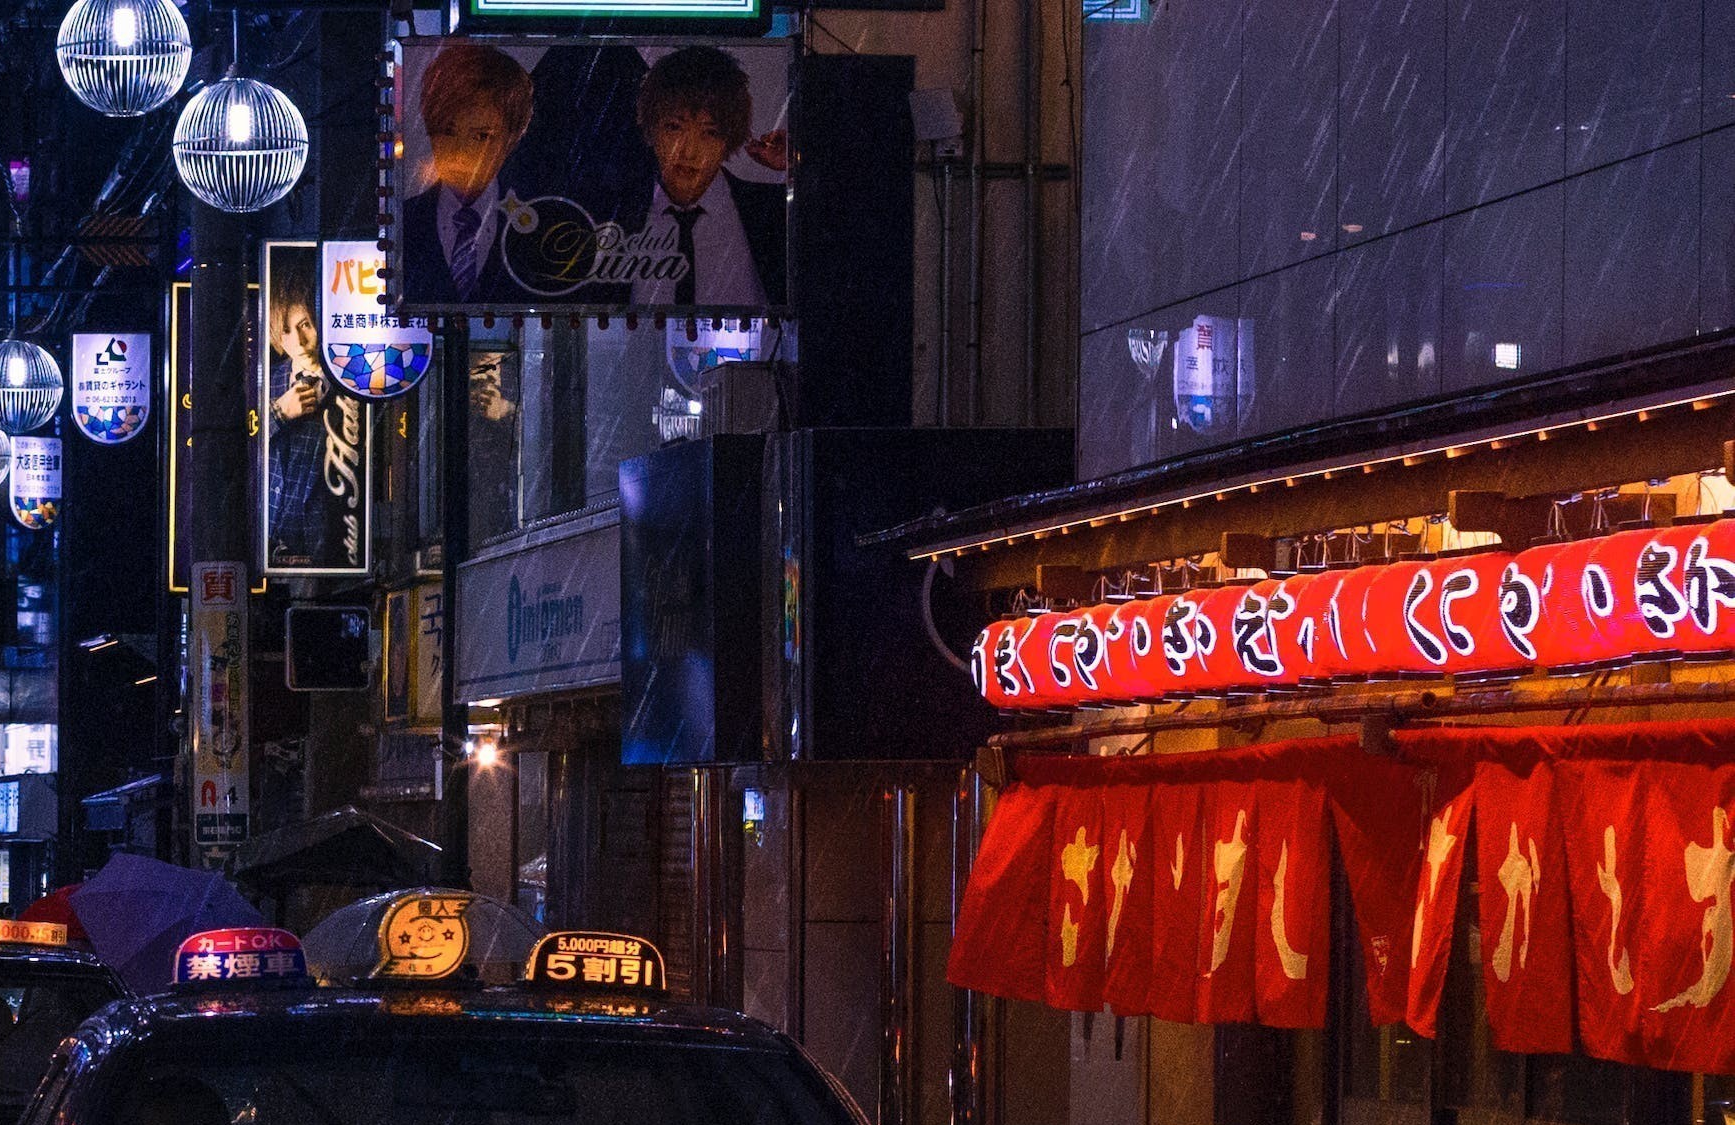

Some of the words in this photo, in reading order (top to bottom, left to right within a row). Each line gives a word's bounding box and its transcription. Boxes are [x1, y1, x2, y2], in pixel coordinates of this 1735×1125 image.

[187, 953, 299, 980] 禁煙車
[546, 955, 653, 985] 5割引
